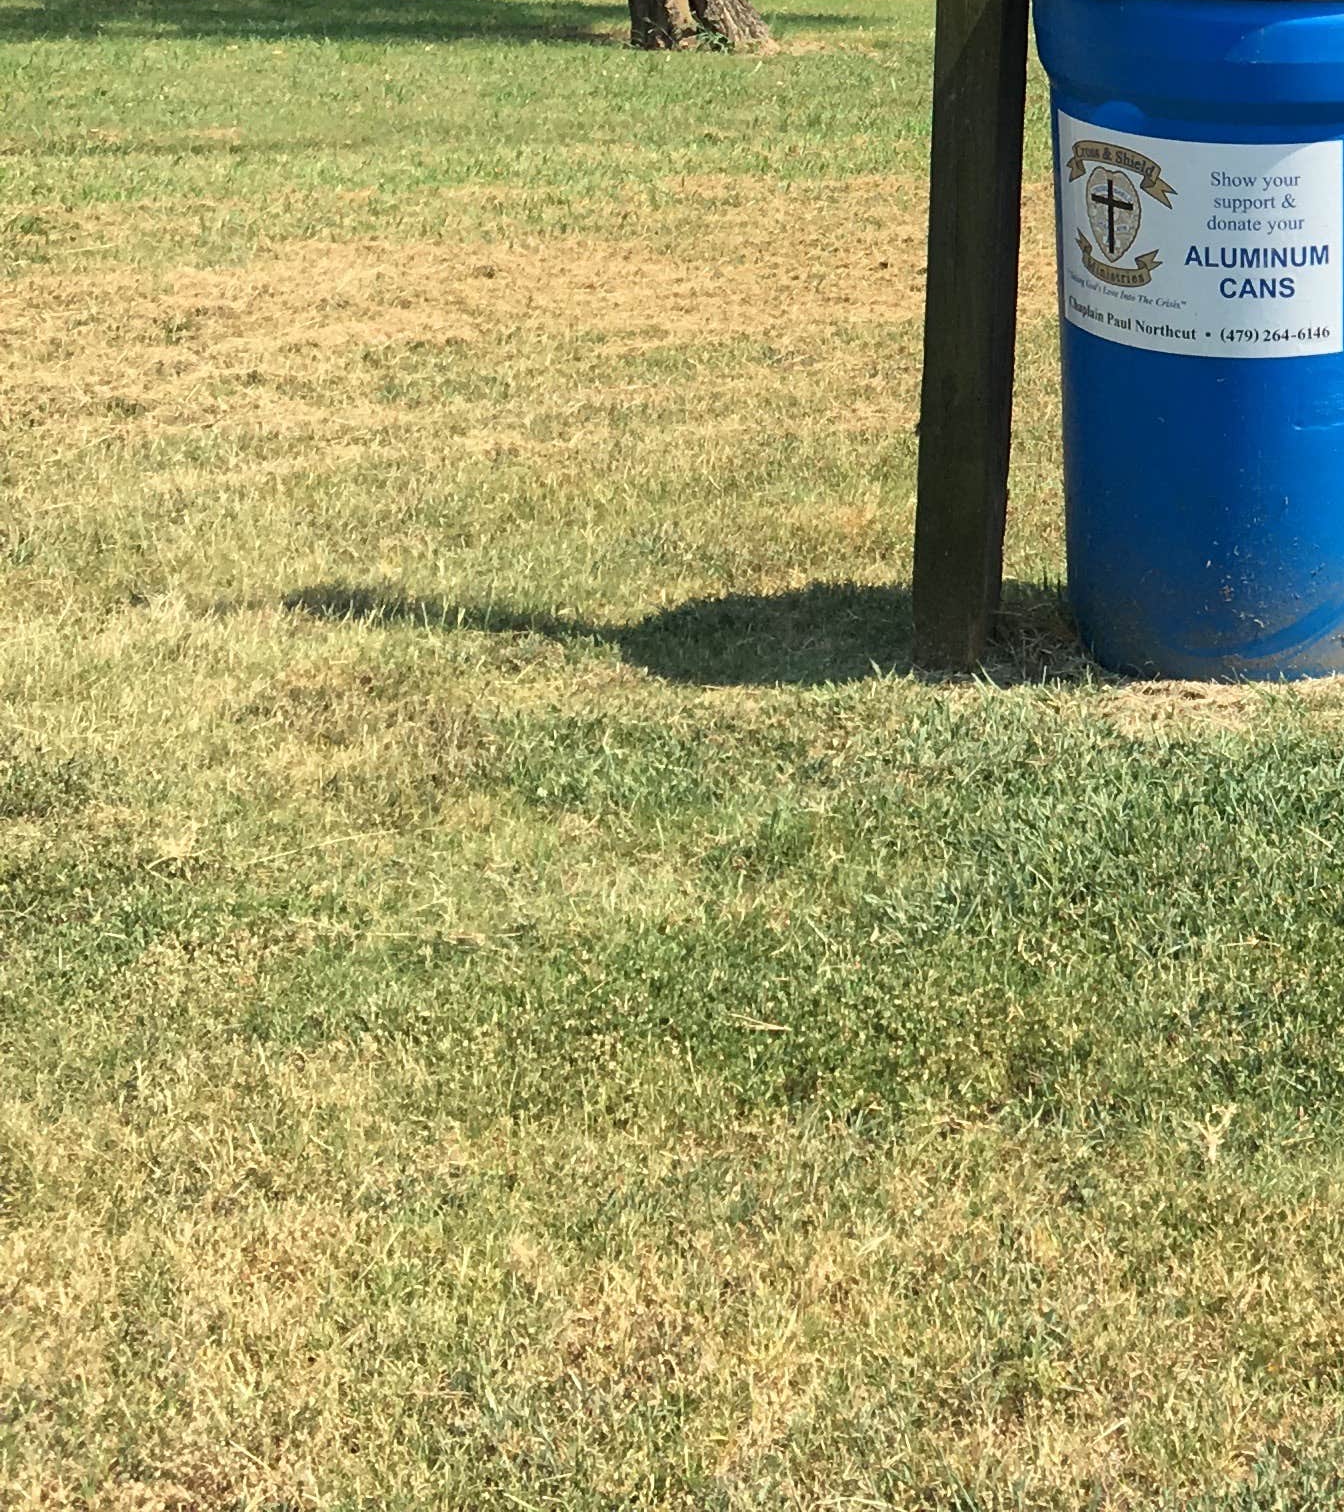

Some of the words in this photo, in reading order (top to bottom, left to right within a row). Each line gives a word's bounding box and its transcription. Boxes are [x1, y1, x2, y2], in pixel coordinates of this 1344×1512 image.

[1210, 171, 1257, 187] Show
[1262, 176, 1300, 191] your
[1214, 196, 1275, 214] support
[1281, 193, 1296, 209] &
[1206, 215, 1261, 231] donate
[1267, 219, 1304, 235] your
[1184, 244, 1330, 268] ALUMINUM
[1219, 277, 1294, 298] CANS
[1107, 312, 1132, 331] Paul
[1135, 318, 1196, 341] Northcut
[1220, 327, 1259, 344] (479)
[1263, 326, 1330, 343] 264-6146
